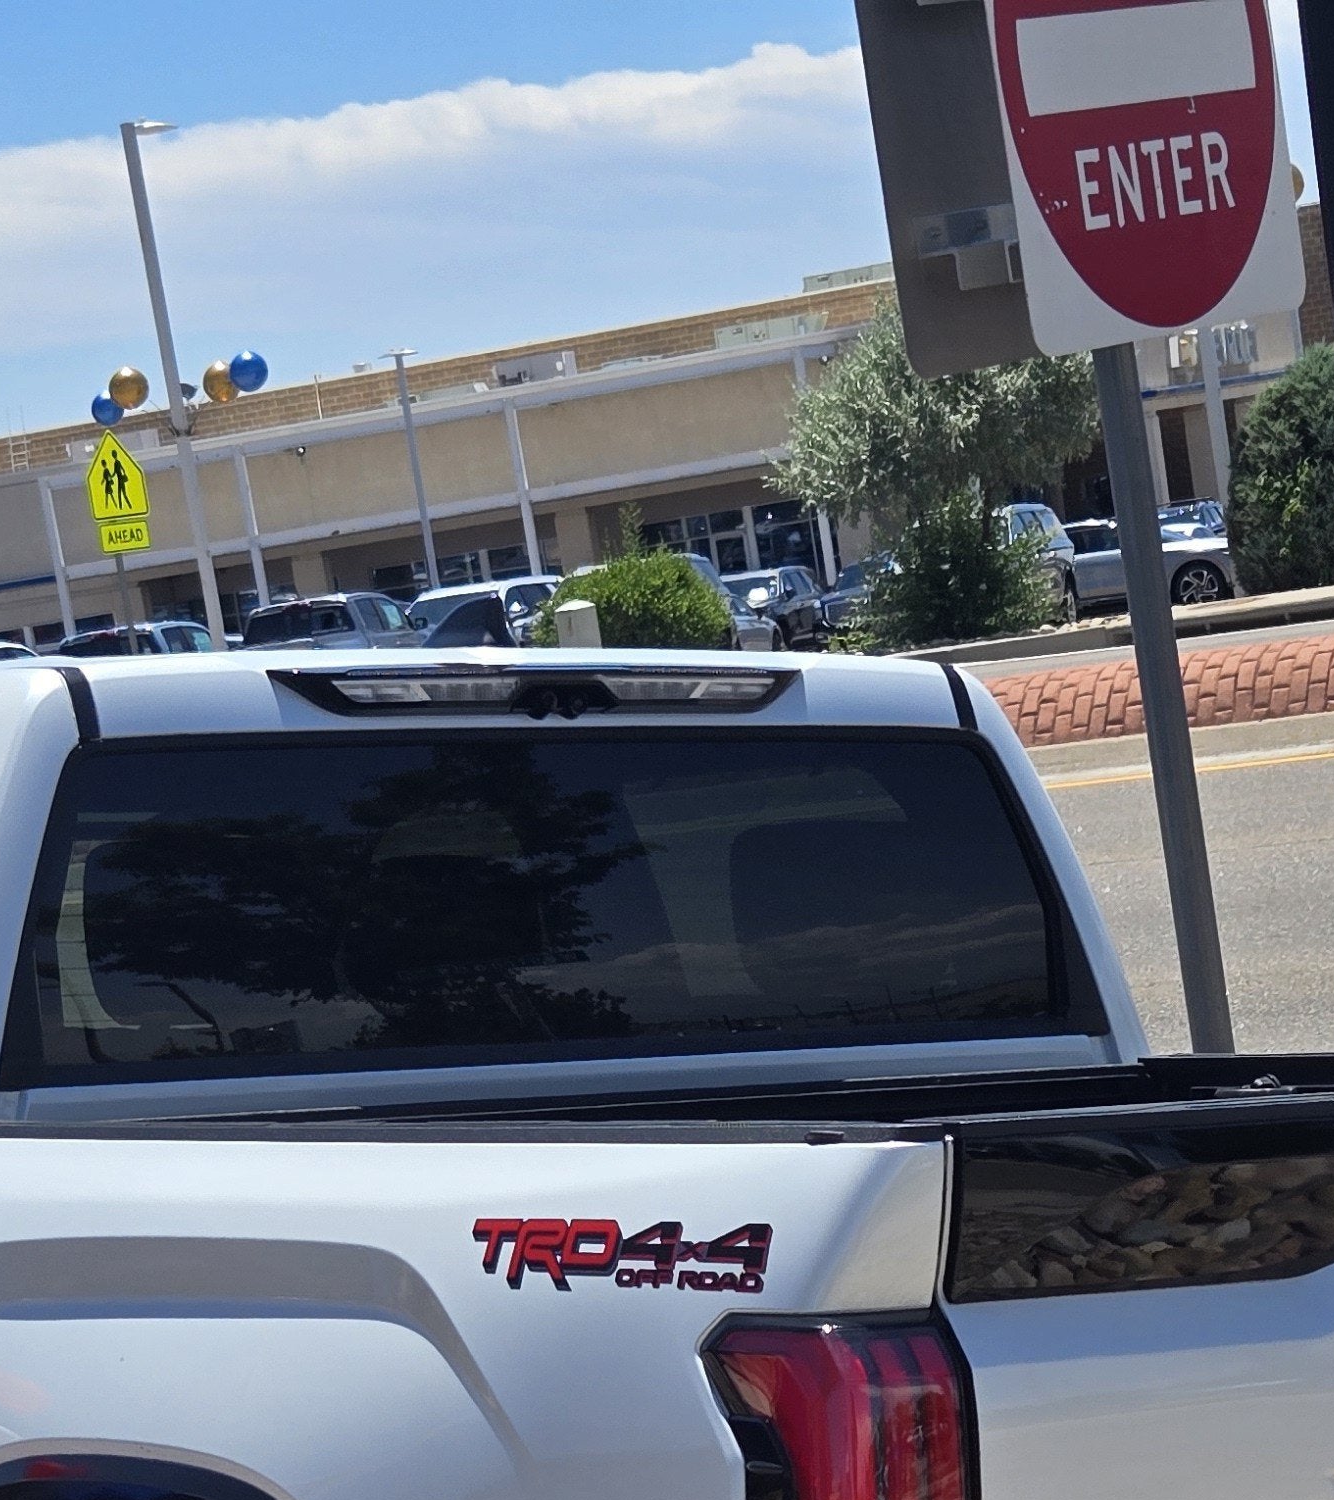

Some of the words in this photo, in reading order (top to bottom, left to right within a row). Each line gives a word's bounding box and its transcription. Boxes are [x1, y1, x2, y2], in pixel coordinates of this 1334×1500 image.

[1074, 131, 1237, 232] ENTER
[107, 528, 144, 545] AHEAD
[472, 1218, 623, 1292] TRD
[615, 1268, 675, 1290] OFF
[677, 1269, 765, 1294] ROAD
